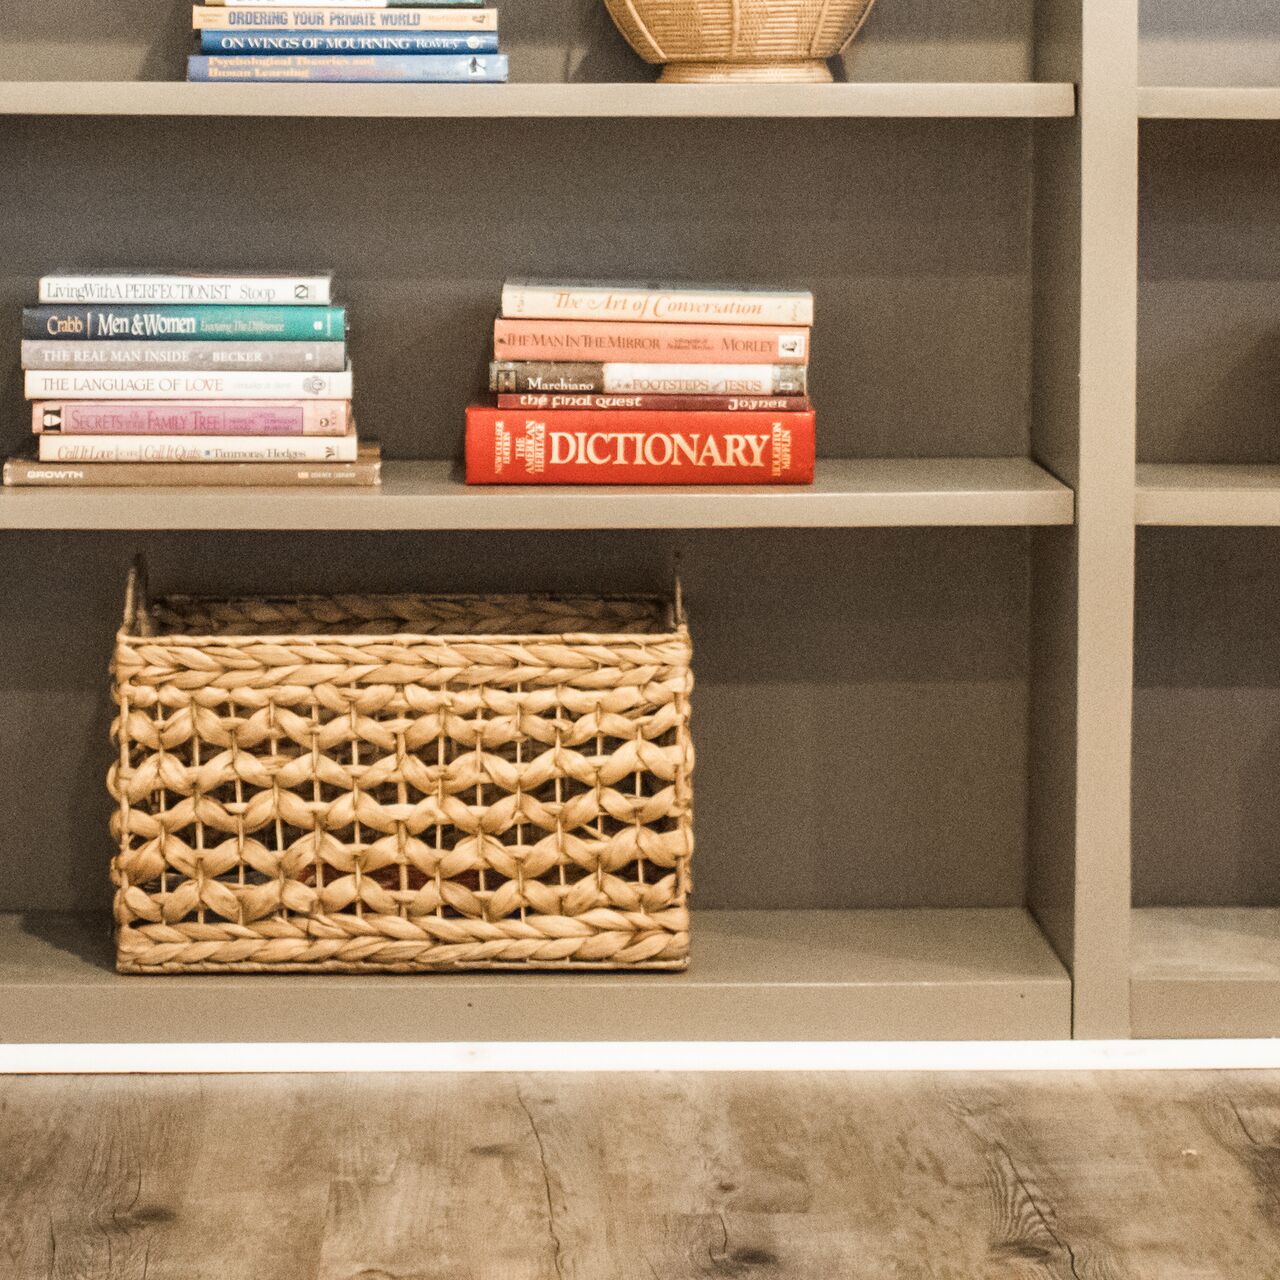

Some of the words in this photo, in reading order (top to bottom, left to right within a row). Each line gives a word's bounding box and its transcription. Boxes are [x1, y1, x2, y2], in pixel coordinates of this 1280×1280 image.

[228, 11, 288, 25] ORDERING
[294, 11, 325, 25] YOUR
[329, 12, 377, 26] PRIVATE
[380, 13, 421, 26] WORLD
[221, 37, 244, 49] ON
[247, 37, 300, 49] WINGS
[302, 37, 322, 49] OF
[325, 37, 410, 49] MOURNING
[208, 56, 292, 66] Psychological
[296, 57, 351, 66] Theories
[352, 57, 375, 66] and
[208, 68, 251, 78] Human
[254, 68, 310, 78] Learning
[125, 283, 232, 299] PERFECTIONIST
[239, 284, 276, 301] Stoop
[554, 291, 579, 308] The
[586, 293, 627, 310] Art
[632, 295, 649, 318] of
[653, 294, 762, 317] Conversation
[47, 315, 83, 335] Crabb
[97, 313, 129, 336] Men
[507, 333, 529, 346] THE
[529, 334, 563, 347] MAN
[581, 334, 607, 347] THE
[607, 335, 661, 349] MIRROR
[721, 337, 775, 352] MORLEY
[42, 350, 70, 362] THE
[74, 350, 106, 362] REAL
[107, 350, 142, 362] MAN
[144, 350, 190, 362] INSIDE
[212, 351, 263, 362] BECKER
[41, 377, 69, 391] THE
[73, 377, 154, 391] LANGUAGE
[158, 378, 182, 391] OF
[185, 378, 223, 391] LOVE
[527, 377, 594, 390] Marchiano
[632, 379, 709, 391] FOOTSTEPS
[724, 379, 762, 392] JESUS
[520, 394, 548, 408] the
[552, 395, 592, 408] final
[596, 396, 643, 408] quest
[71, 409, 120, 430] SECRETS
[147, 410, 187, 431] FAMILY
[191, 410, 220, 431] TREE
[267, 448, 307, 460] Hedges
[516, 437, 525, 460] THE
[525, 419, 535, 474] AMERICAN
[535, 422, 545, 472] HERITAGE
[549, 431, 770, 467] DICTIONARY
[772, 422, 782, 477] HOUGHTON
[781, 430, 791, 470] MIFFLIN
[27, 471, 84, 479] GROWTH
